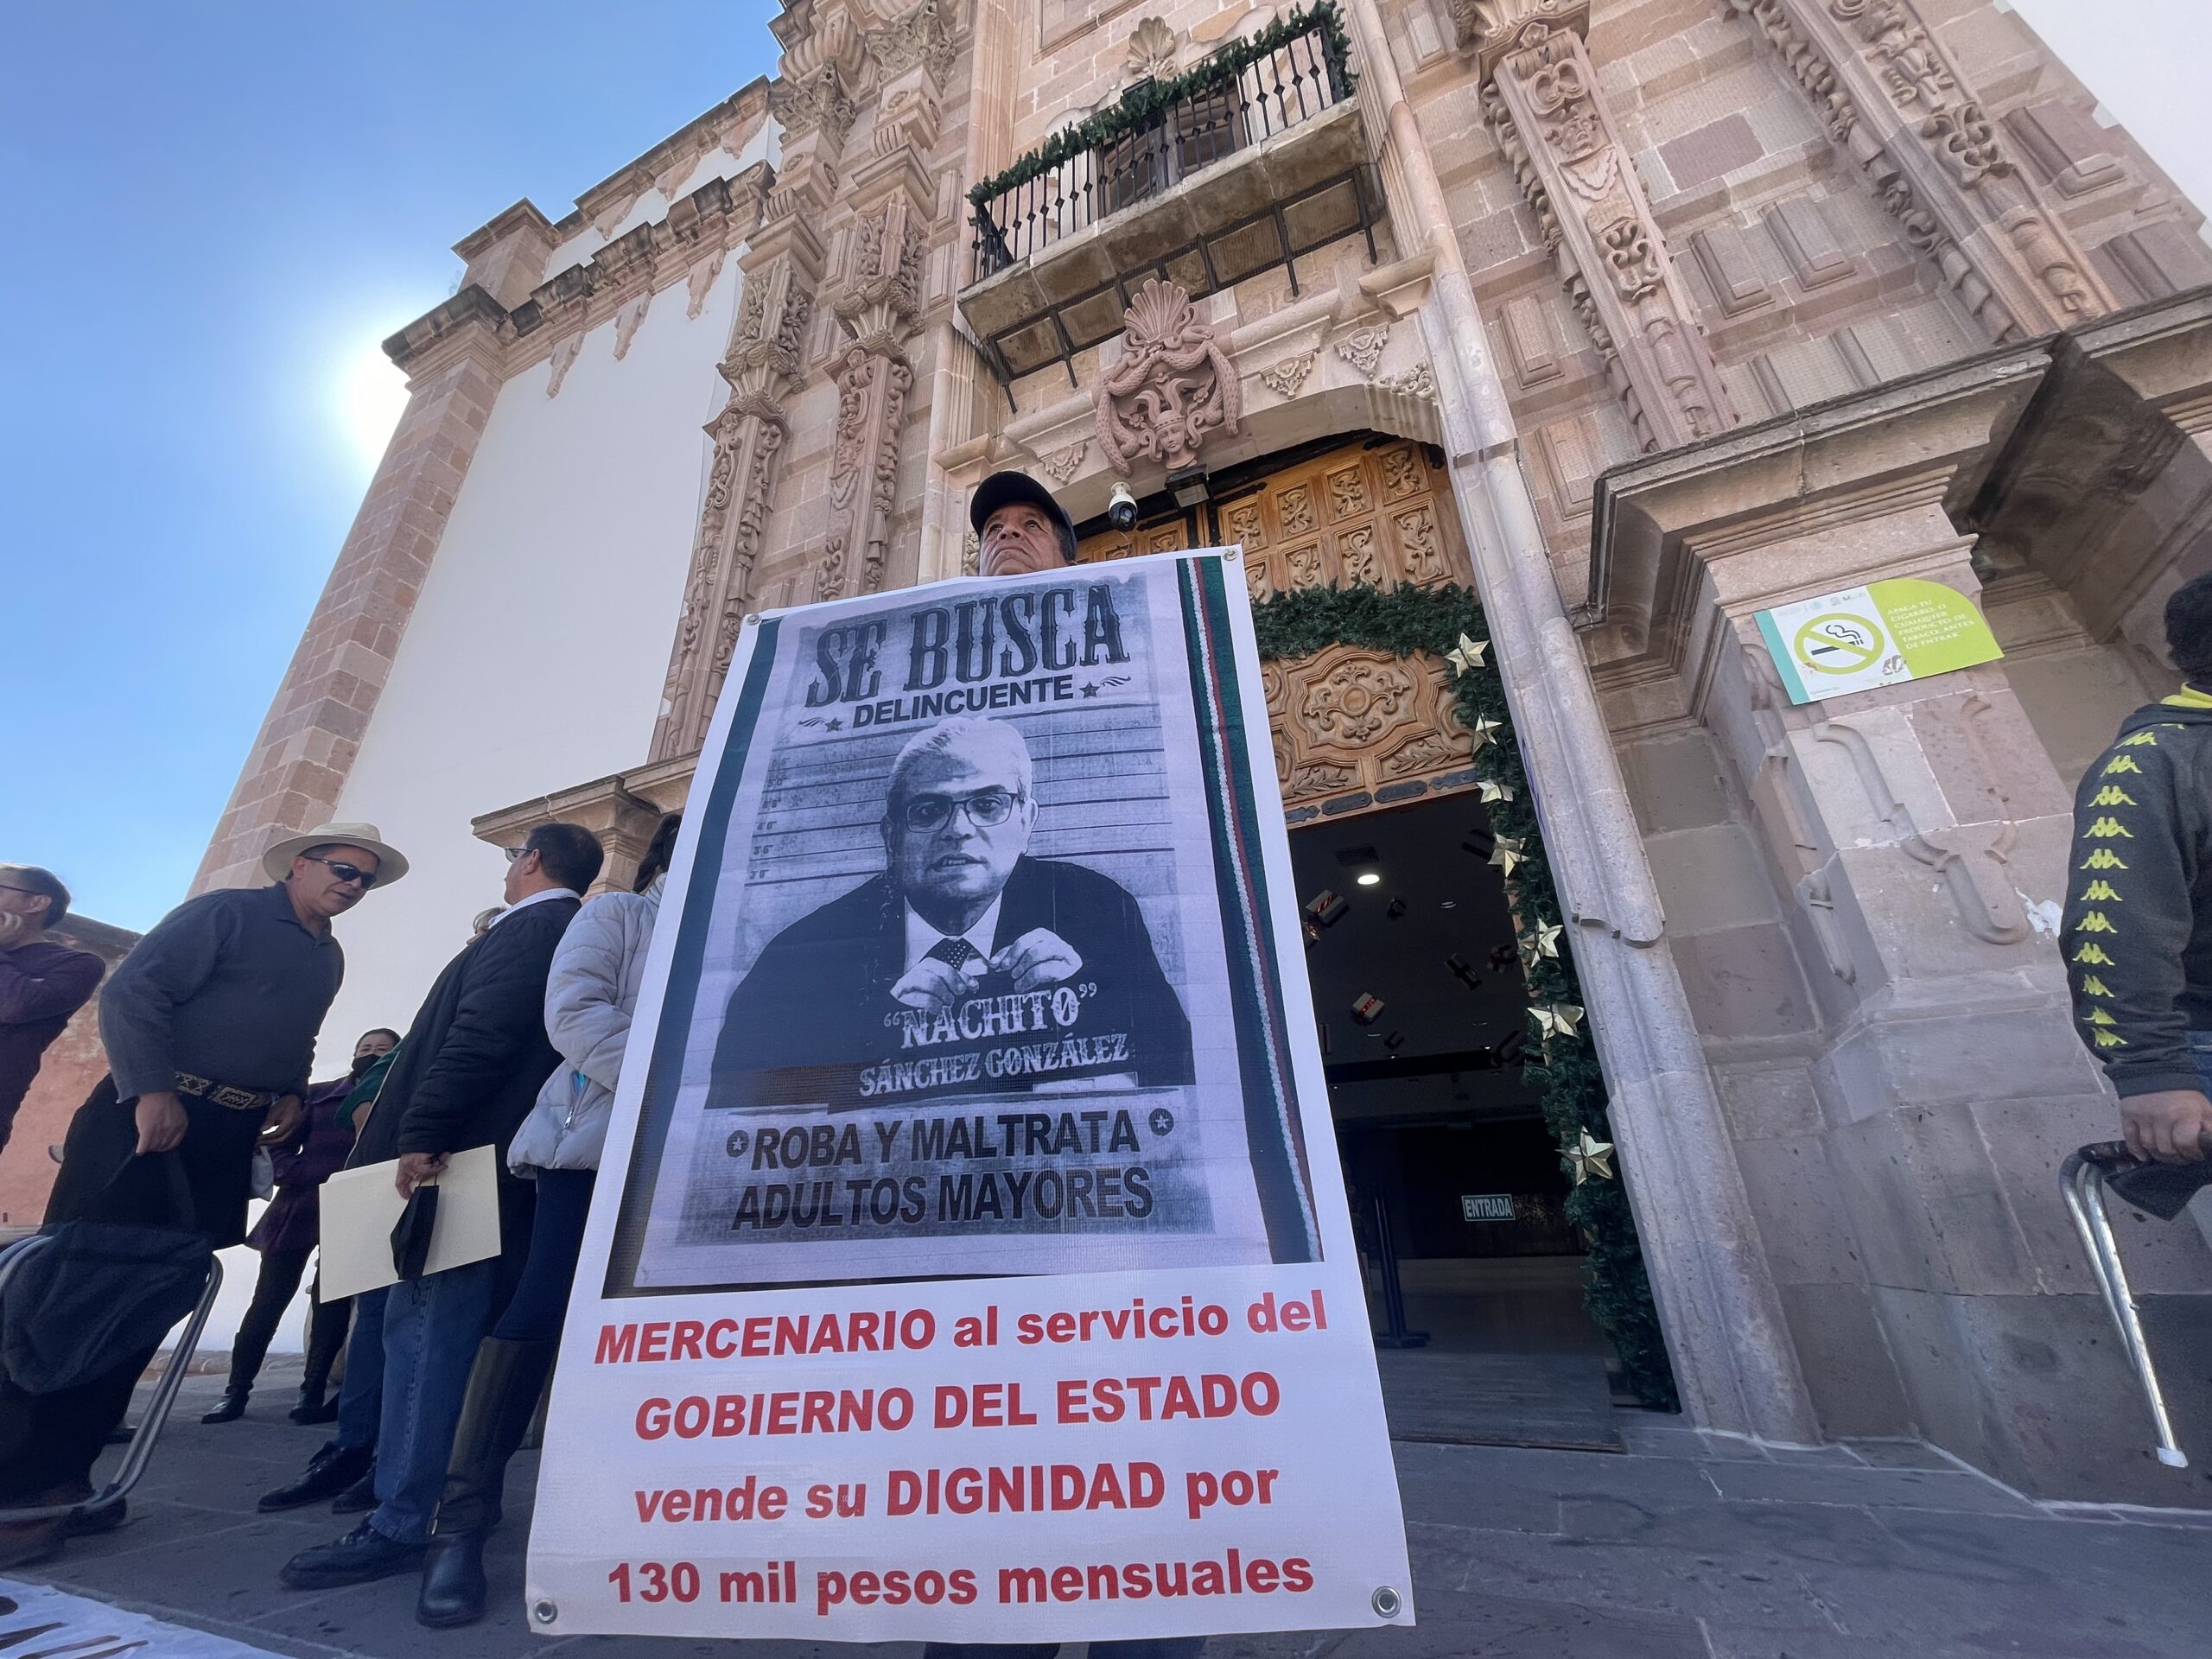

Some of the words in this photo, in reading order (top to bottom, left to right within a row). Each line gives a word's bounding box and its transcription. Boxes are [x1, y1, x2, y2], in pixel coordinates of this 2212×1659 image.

[804, 619, 887, 708] SE
[903, 584, 1130, 691] BUSCA
[853, 674, 1074, 728] DELINCUENTE
[859, 1058, 981, 1096] SÁNCHEZ
[985, 1033, 1129, 1077] GONZÁLEZ
[751, 1124, 861, 1170] ROBA
[874, 1121, 903, 1163] Y
[911, 1109, 1141, 1161] MALTRATA
[732, 1176, 927, 1230] ADULTOS
[938, 1166, 1154, 1222] MAYORES
[1464, 1198, 1513, 1217] ENTRADA
[594, 1308, 935, 1363] MERCENARIO
[953, 1306, 998, 1348] al
[1016, 1295, 1229, 1344] servicio
[1248, 1289, 1327, 1333] del
[635, 1387, 914, 1440] GOBIERNO
[934, 1382, 1037, 1429] DEL
[1057, 1371, 1280, 1424] ESTADO
[635, 1475, 787, 1522] vende
[805, 1483, 866, 1519] su
[887, 1461, 1165, 1516] DIGNIDAD
[1185, 1469, 1279, 1520] por
[608, 1561, 700, 1603] 130
[720, 1560, 796, 1602] mil
[817, 1568, 977, 1616] pesos
[999, 1548, 1313, 1604] mensuales
